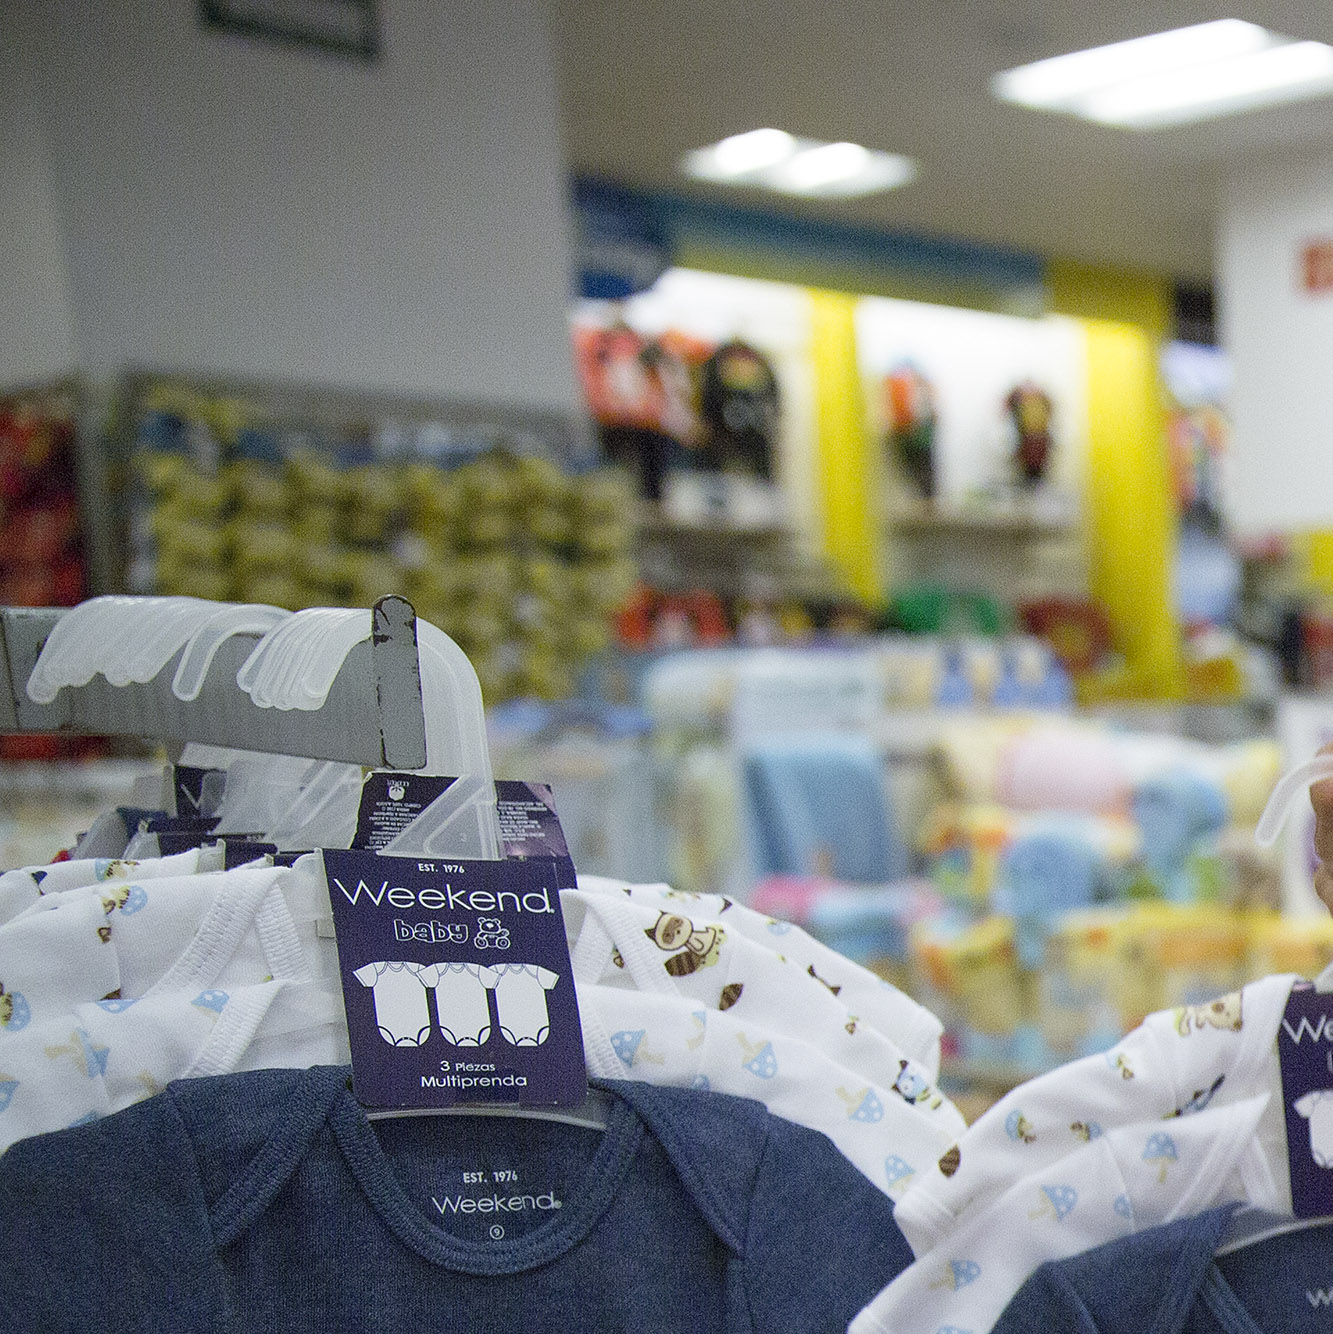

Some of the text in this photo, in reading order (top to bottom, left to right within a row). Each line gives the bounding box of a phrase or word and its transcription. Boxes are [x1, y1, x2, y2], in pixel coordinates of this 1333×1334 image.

[417, 863, 465, 874] EST. 1976
[333, 878, 554, 914] Weekend
[394, 918, 469, 943] baby
[440, 1060, 496, 1072] 3 Piezas
[420, 1074, 528, 1089] Multiprenda
[463, 1170, 518, 1183] EST. 1976
[431, 1191, 559, 1215] Weekend
